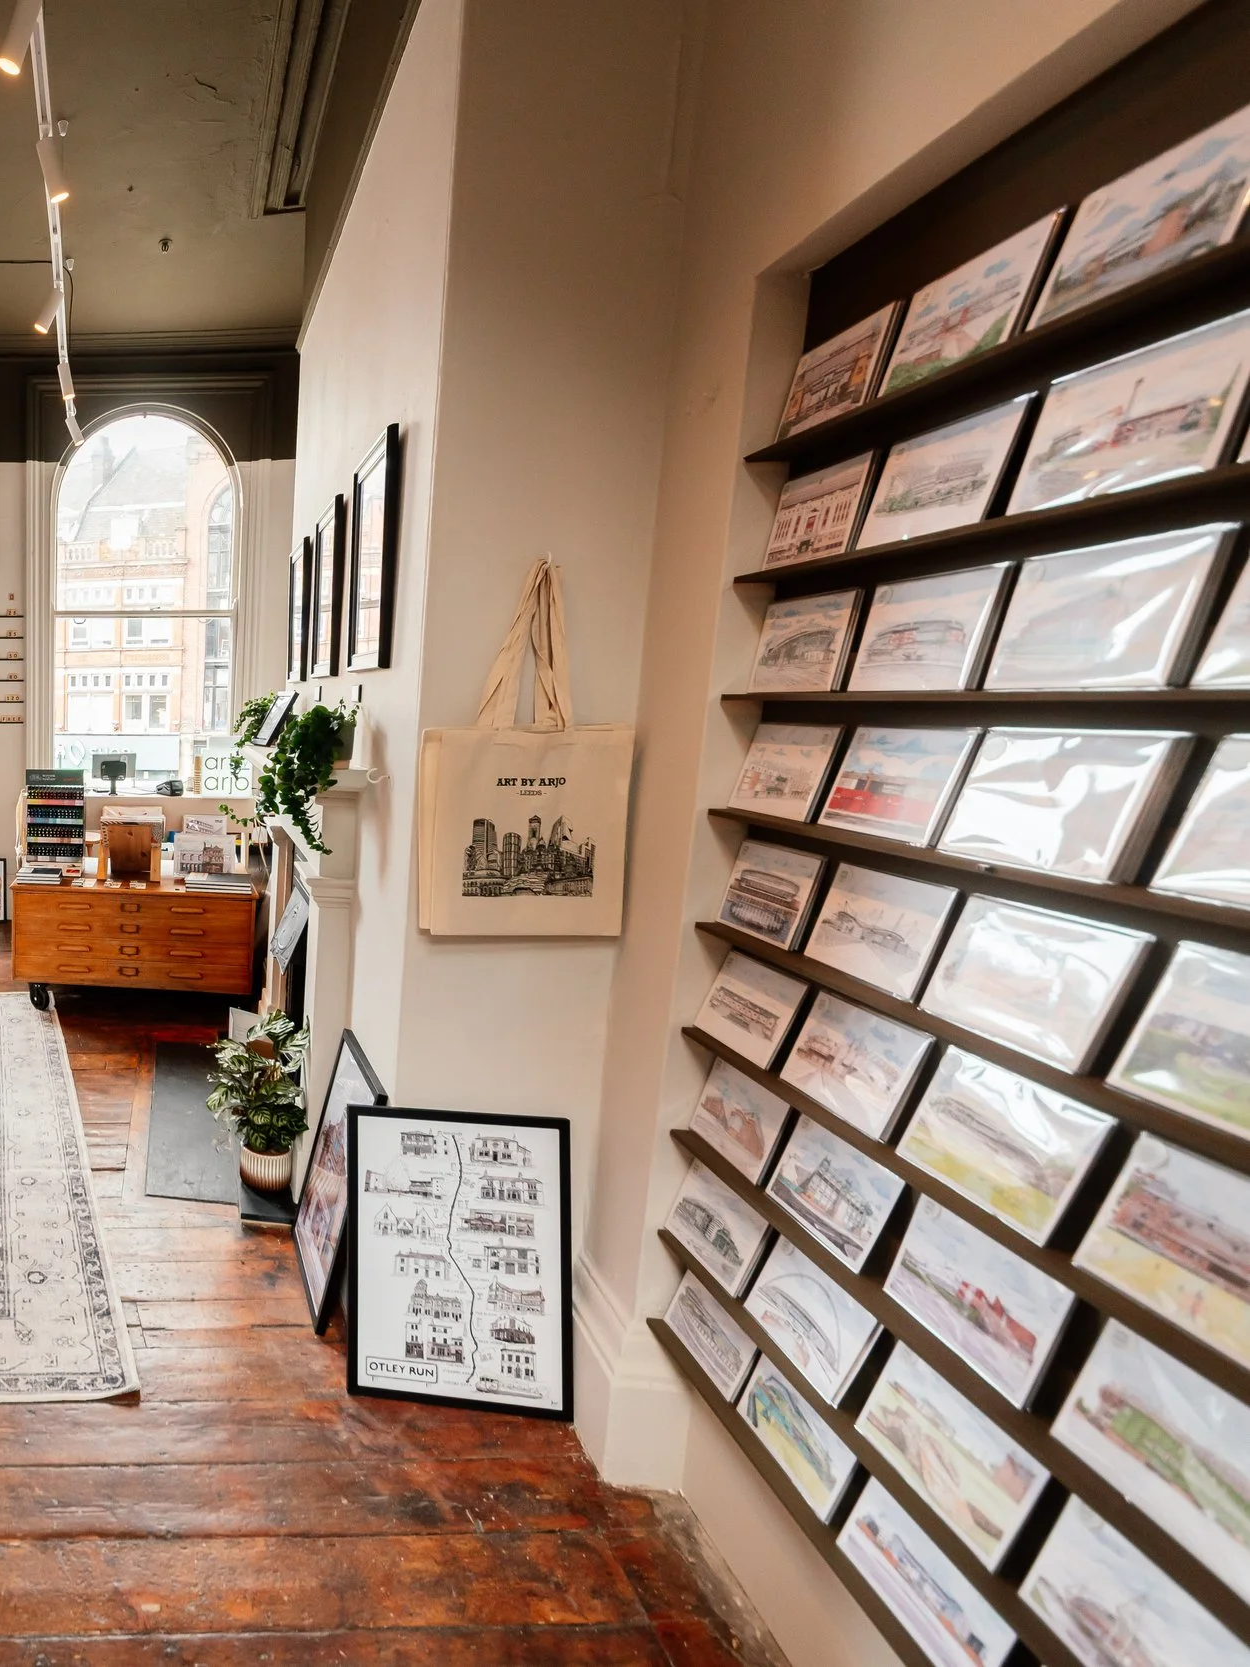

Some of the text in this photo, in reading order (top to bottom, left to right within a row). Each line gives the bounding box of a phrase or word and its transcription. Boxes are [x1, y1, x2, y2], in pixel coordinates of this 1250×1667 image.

[204, 776, 249, 794] arjo
[496, 777, 566, 788] ART BY ARJO
[369, 1361, 405, 1374] OTLEY
[409, 1366, 434, 1377] RUN
